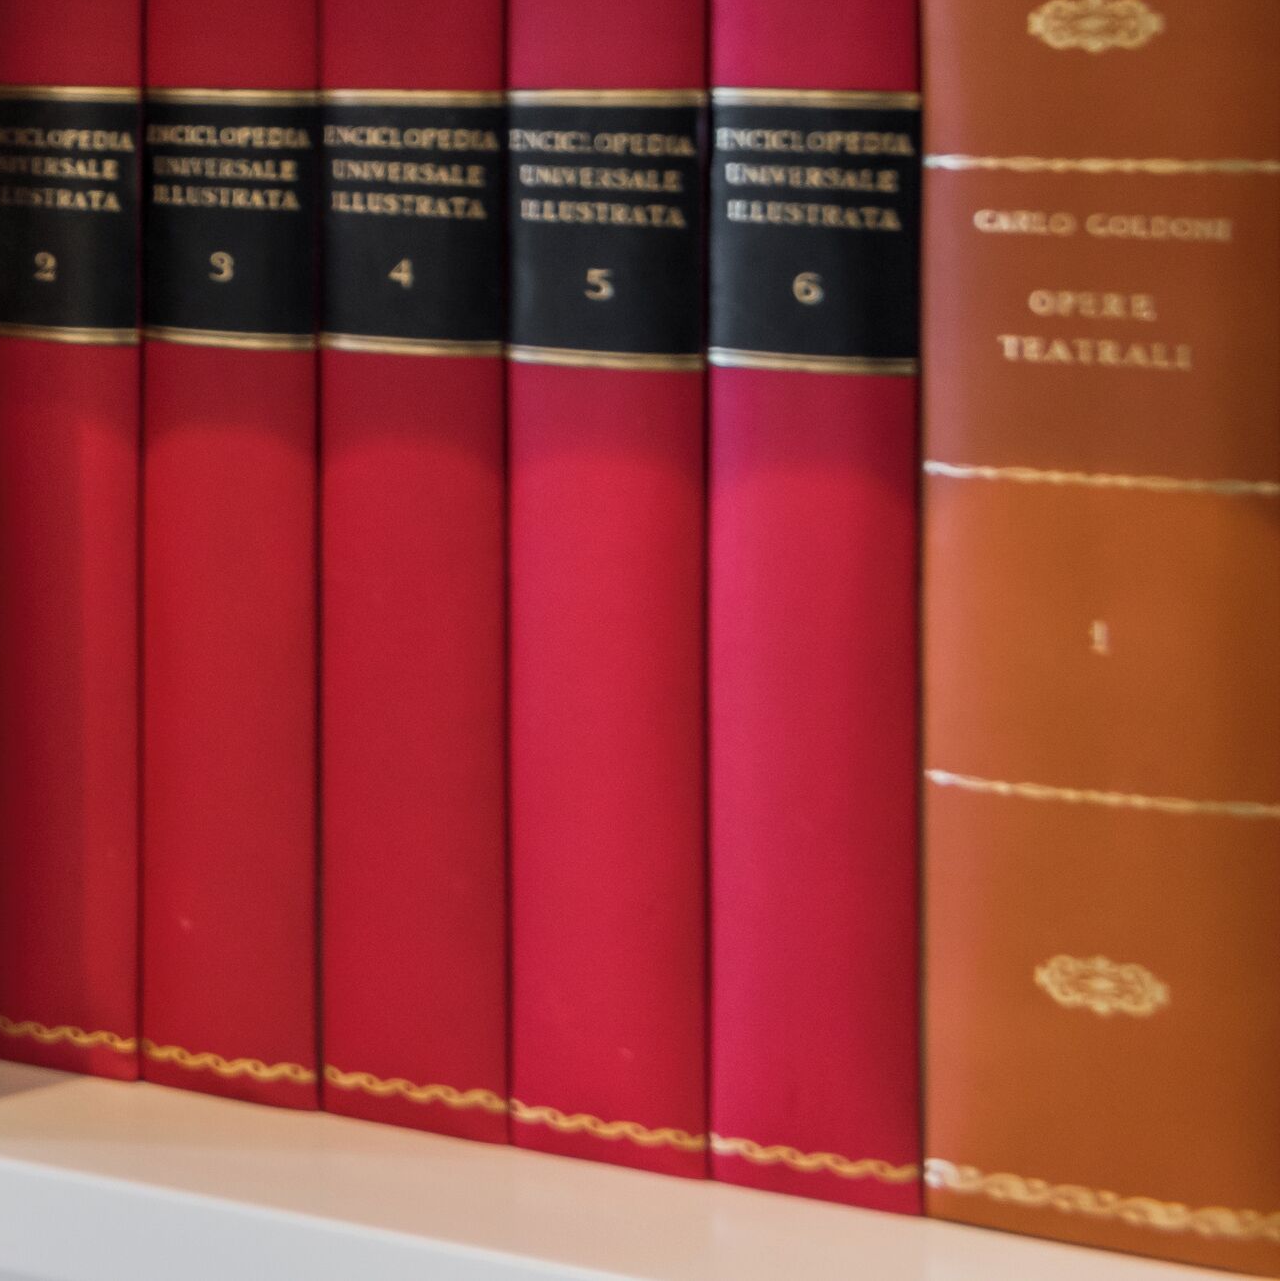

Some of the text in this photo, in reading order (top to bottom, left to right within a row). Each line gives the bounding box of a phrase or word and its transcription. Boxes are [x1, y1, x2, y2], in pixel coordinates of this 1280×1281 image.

[146, 124, 312, 149] ENCICLOPEDIA
[324, 124, 500, 152] ENCICLOPEDIA
[509, 128, 695, 157] ENCICLOPEDIA
[715, 126, 915, 156] ENCICLOPEDIA
[332, 158, 486, 187] UNIVERSALE
[519, 164, 684, 193] UNIVERSALE
[725, 162, 900, 193] UNIVERSALE
[331, 191, 487, 219] ILLUSTRATA
[520, 198, 686, 229] ILLUSTRATA
[726, 199, 902, 232] ILLUSTRATA
[973, 208, 1077, 237] CARLO
[34, 251, 57, 282] 2
[209, 250, 235, 283] 3
[388, 257, 414, 289] 4
[584, 268, 614, 301] 5
[793, 271, 824, 306] 6
[1028, 289, 1157, 322] OPERE
[997, 334, 1192, 371] TEATRALI
[1089, 619, 1108, 655] 1
